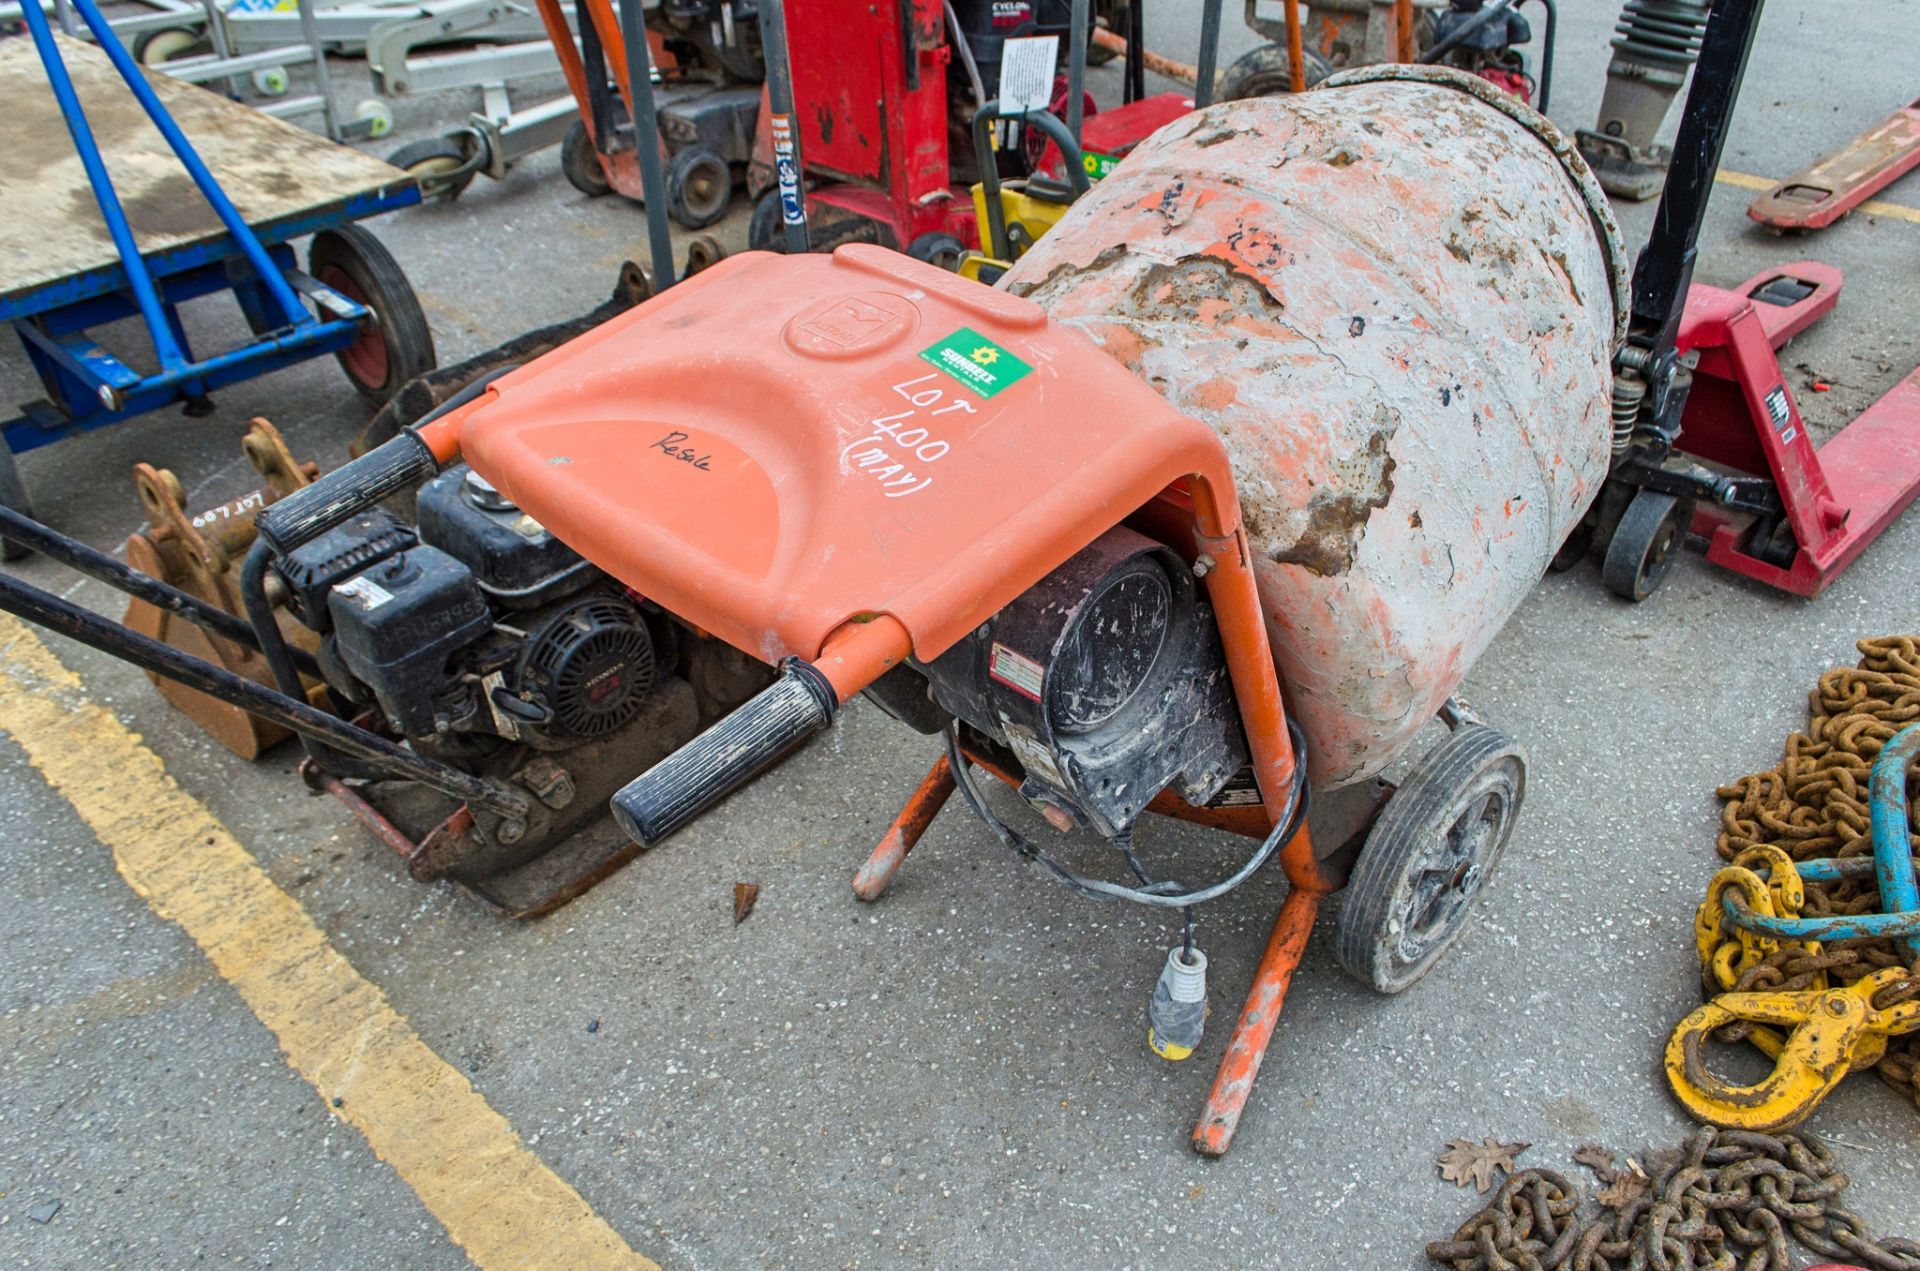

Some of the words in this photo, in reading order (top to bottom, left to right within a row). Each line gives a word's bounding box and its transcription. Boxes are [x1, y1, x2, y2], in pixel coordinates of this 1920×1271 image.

[940, 347, 997, 385] SUNBELT
[942, 357, 980, 382] RENTALS
[891, 372, 977, 415] LOT
[649, 430, 712, 472] Resale
[871, 410, 950, 462] 400
[234, 489, 265, 516] LOT
[584, 662, 625, 688] HONDA
